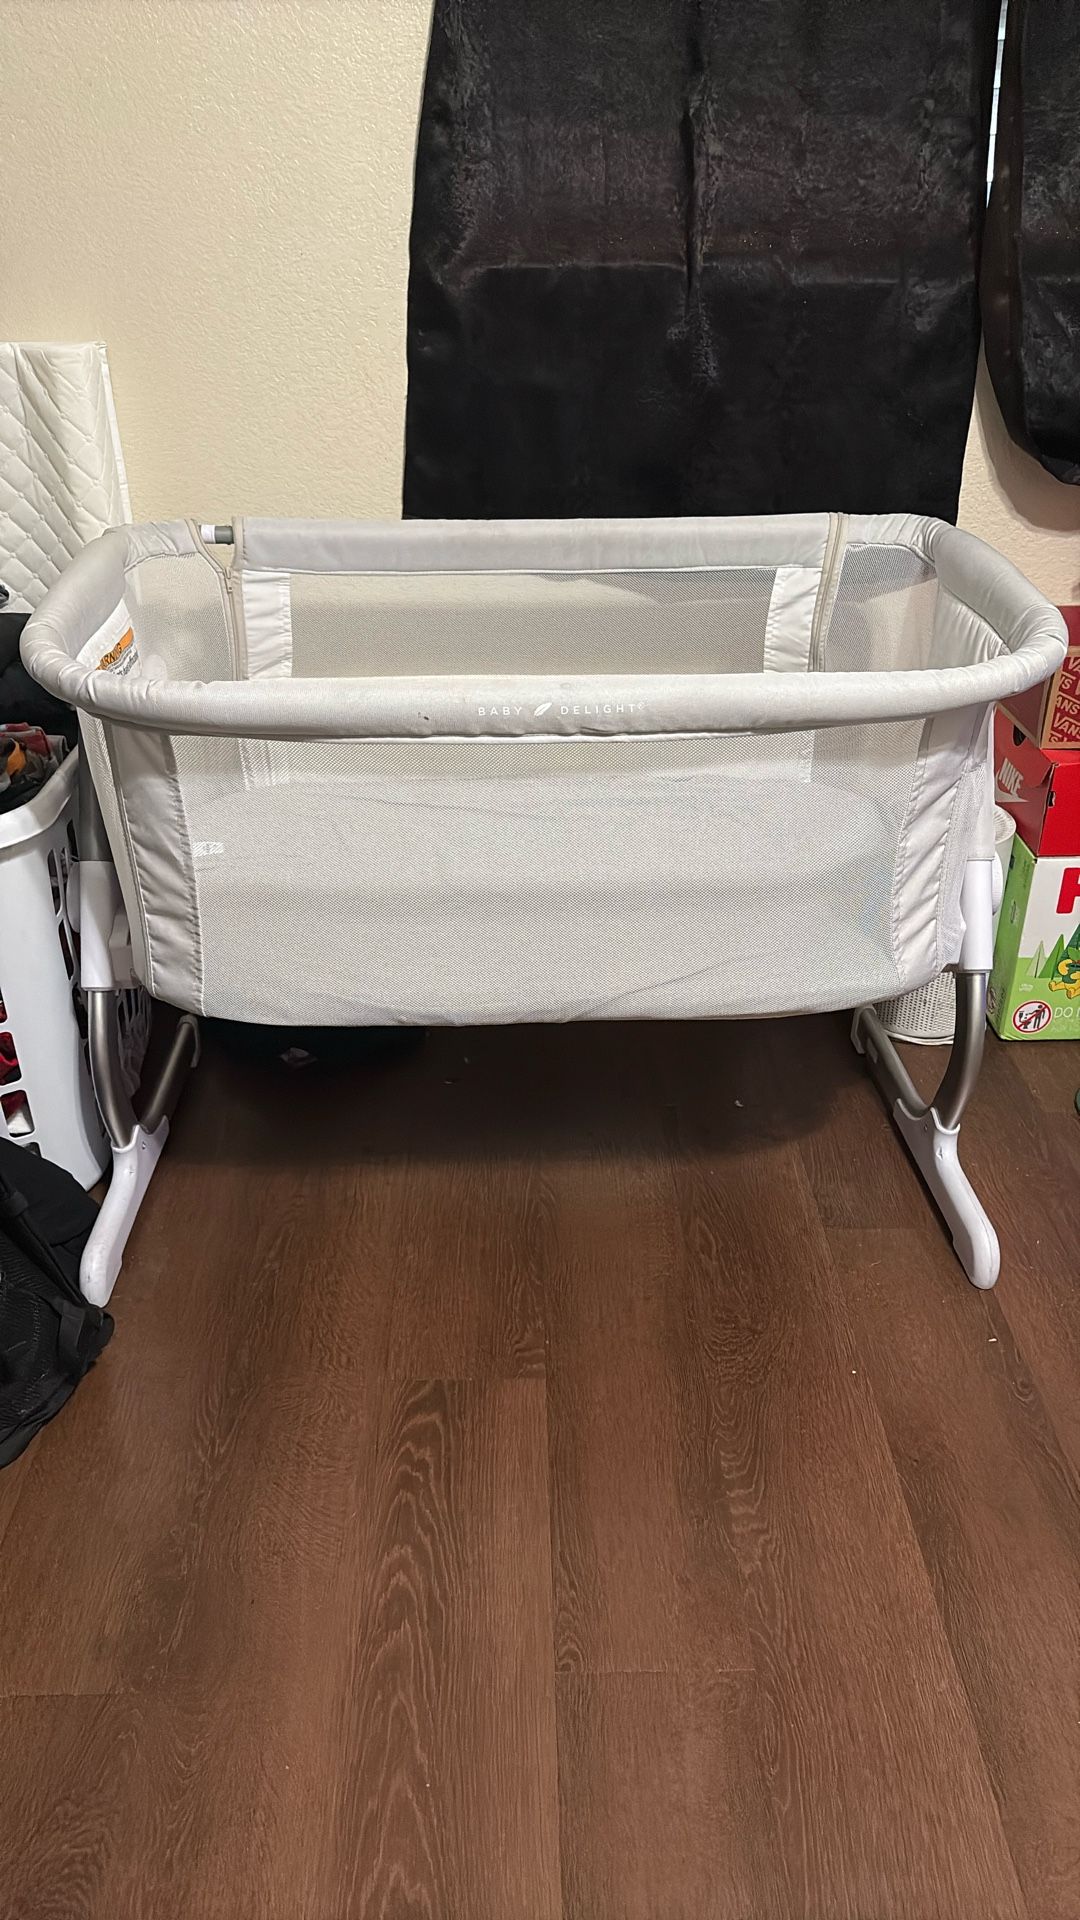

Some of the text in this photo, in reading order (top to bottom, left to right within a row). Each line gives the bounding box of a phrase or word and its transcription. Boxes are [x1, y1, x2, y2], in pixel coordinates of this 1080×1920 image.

[478, 706, 523, 716] BABY
[998, 757, 1024, 795] NIKE
[1054, 1006, 1074, 1018] DO
